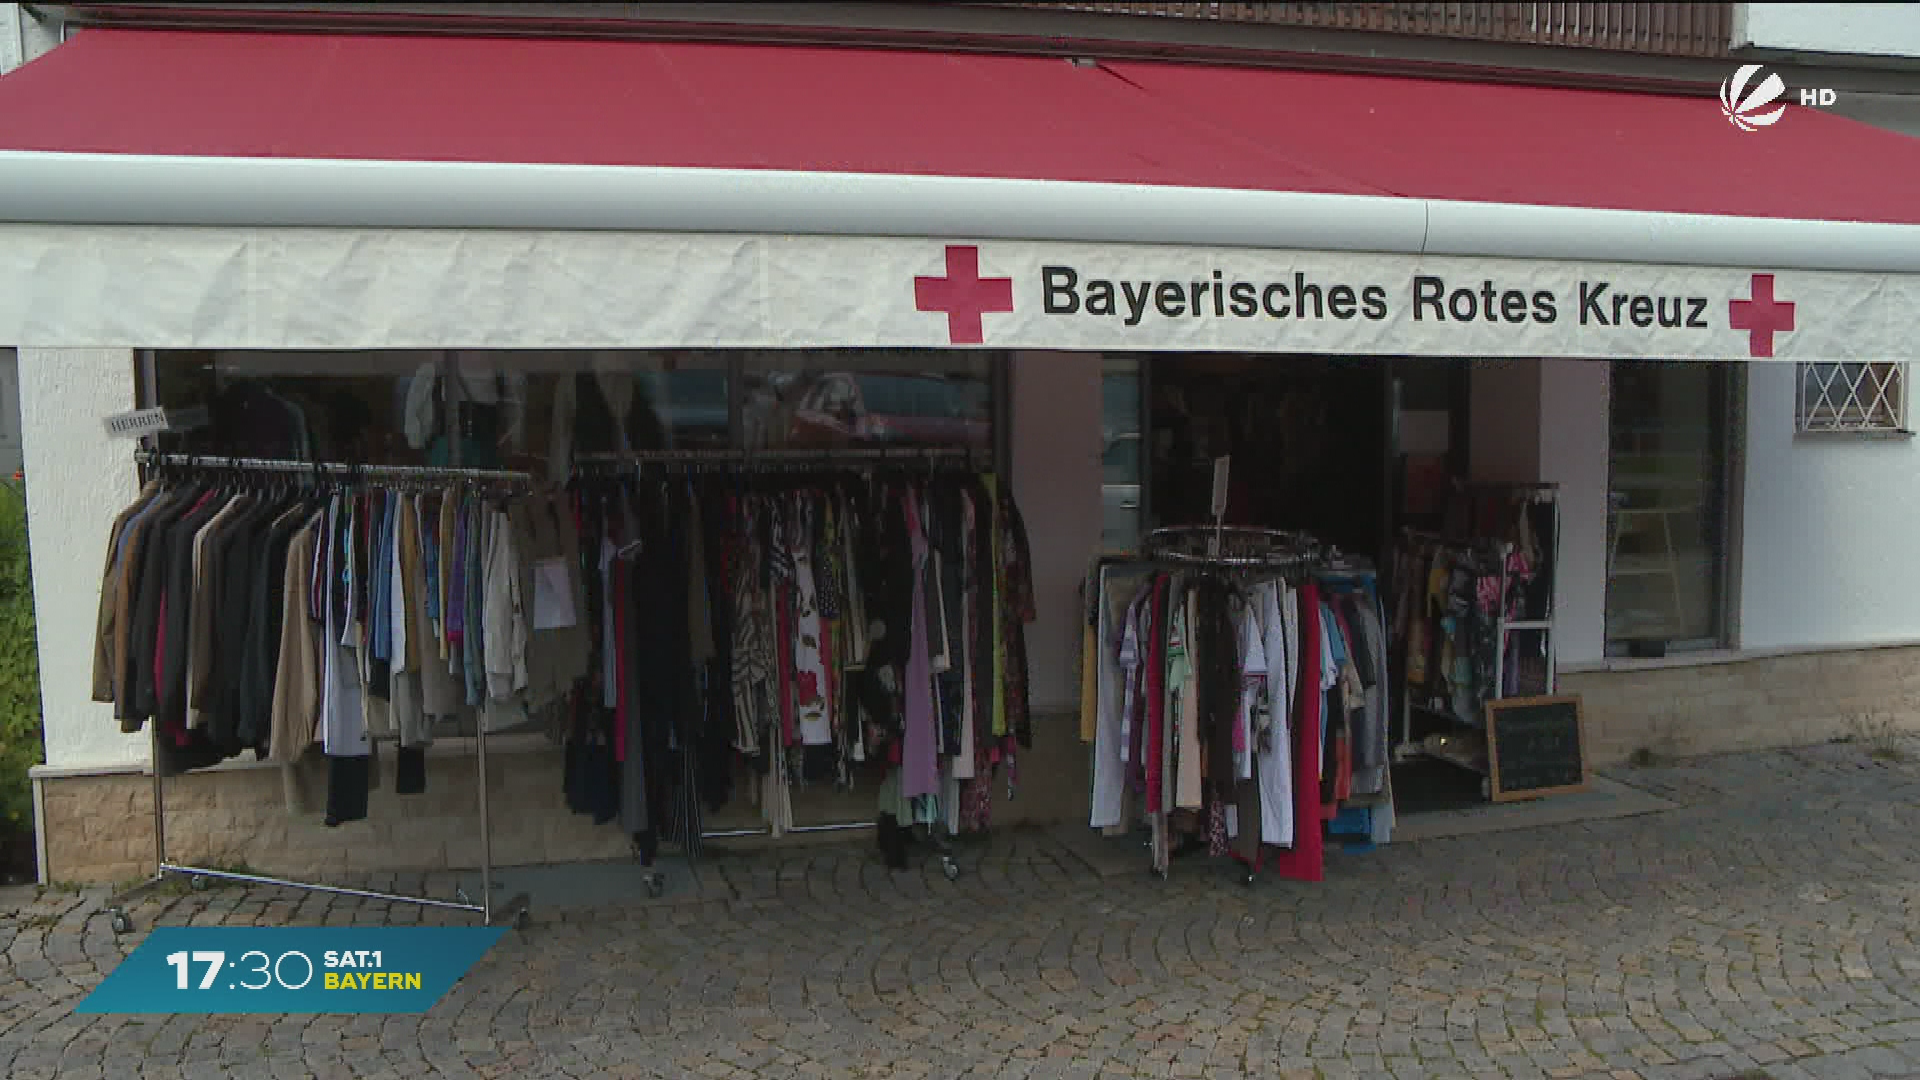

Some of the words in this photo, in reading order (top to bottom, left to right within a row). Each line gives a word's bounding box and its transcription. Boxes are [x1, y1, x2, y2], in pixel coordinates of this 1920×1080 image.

[1041, 266, 1388, 326] Bayerisches
[1413, 276, 1557, 324] Rotes
[1579, 280, 1708, 328] Kreuz
[111, 412, 164, 432] HERREN
